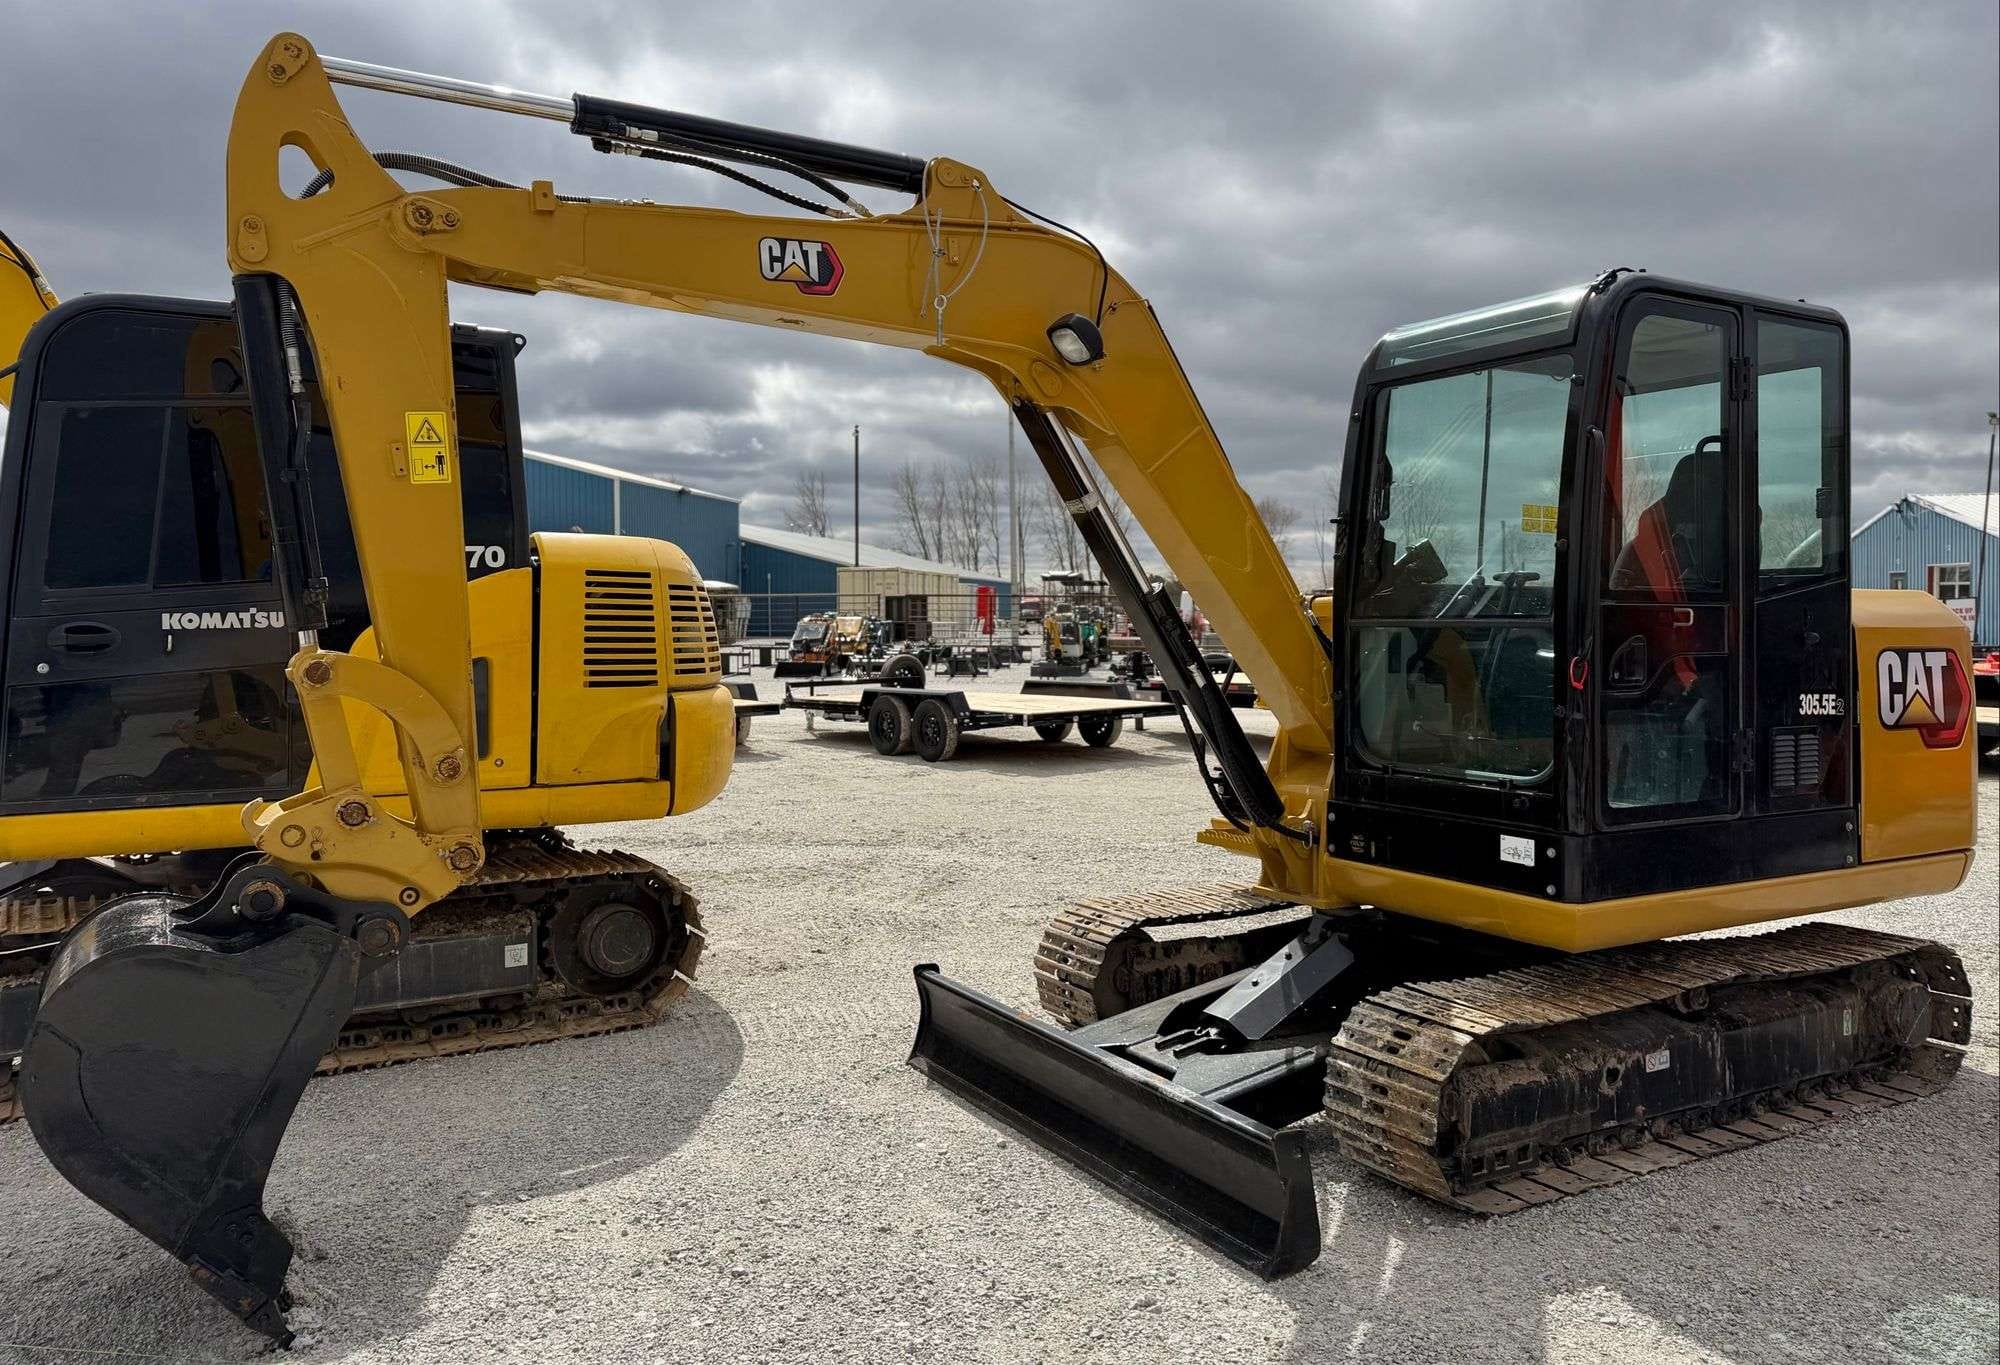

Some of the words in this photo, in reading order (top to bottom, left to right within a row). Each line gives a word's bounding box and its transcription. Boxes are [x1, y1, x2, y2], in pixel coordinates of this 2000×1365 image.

[760, 238, 823, 283] CAT
[465, 545, 506, 568] 70
[161, 607, 285, 630] KOMATSU
[1878, 650, 1948, 726] CAT
